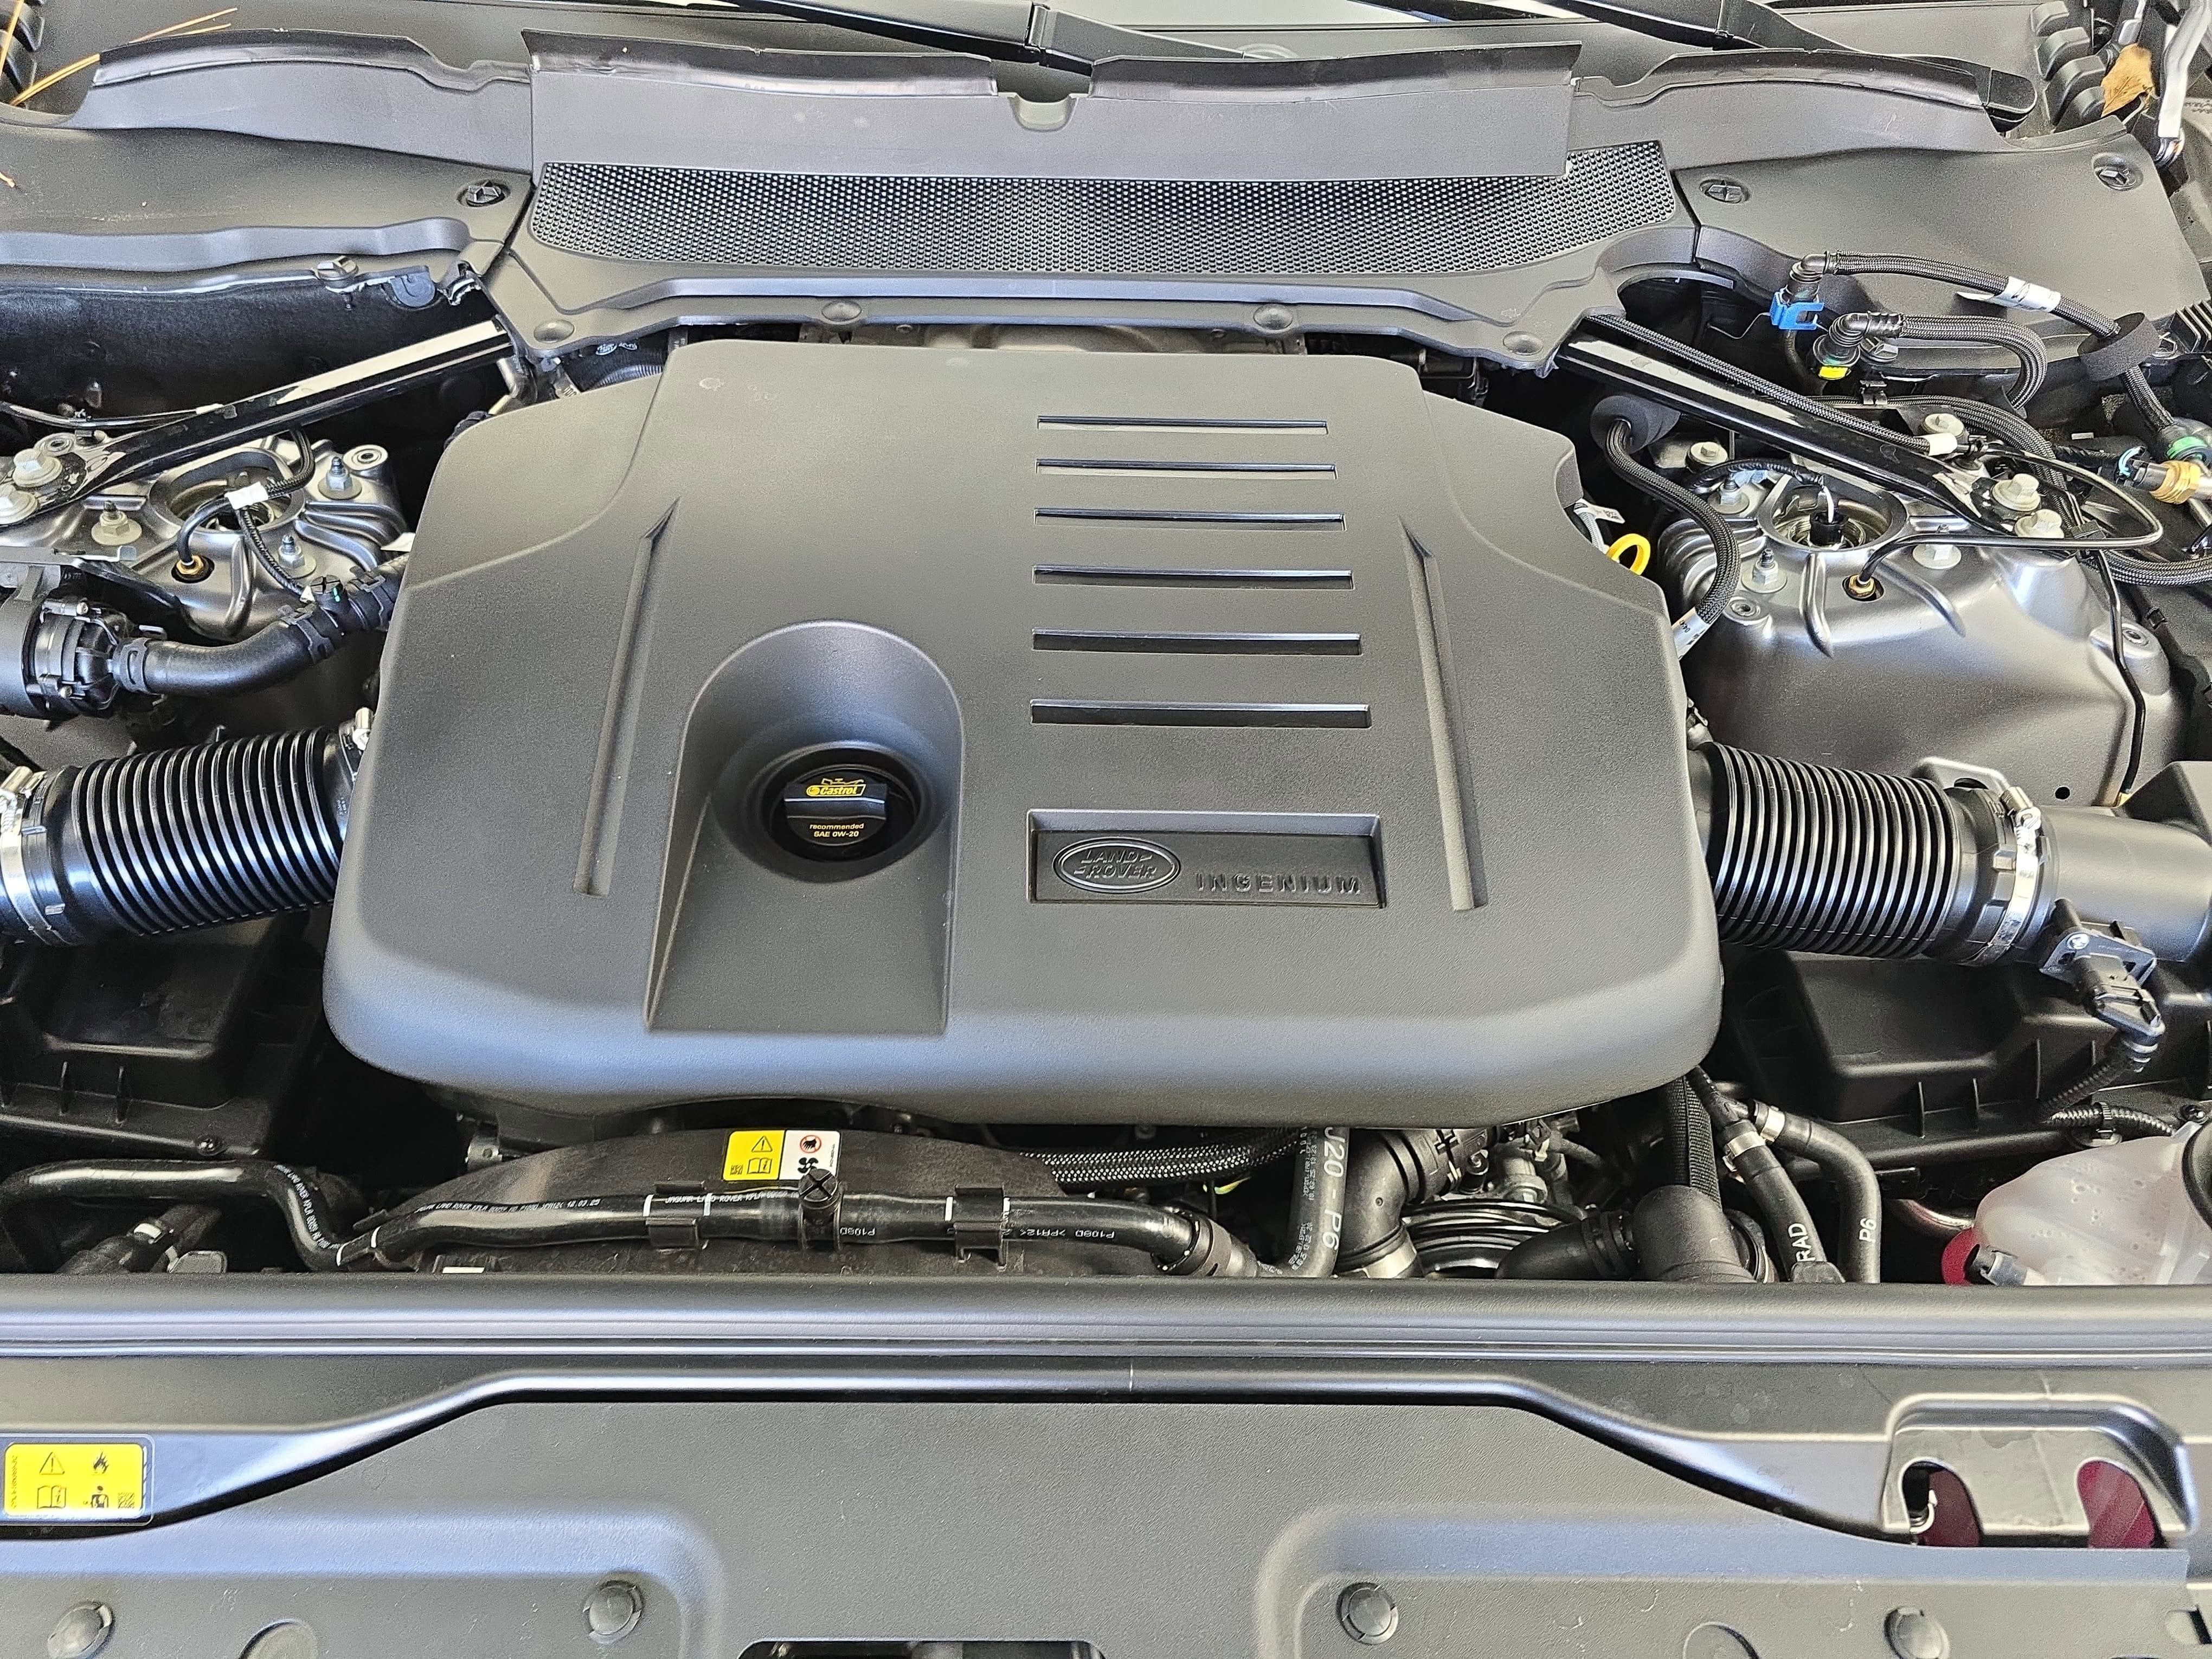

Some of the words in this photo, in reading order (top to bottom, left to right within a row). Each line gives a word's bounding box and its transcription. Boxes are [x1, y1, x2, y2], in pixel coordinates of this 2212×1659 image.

[820, 786, 858, 795] Castrol
[1196, 872, 1362, 895] INGENIUM
[1323, 1127, 1345, 1178] J20
[1322, 1208, 1342, 1251] P6
[1788, 1223, 1816, 1262] RAD
[1859, 1218, 1877, 1244] P6
